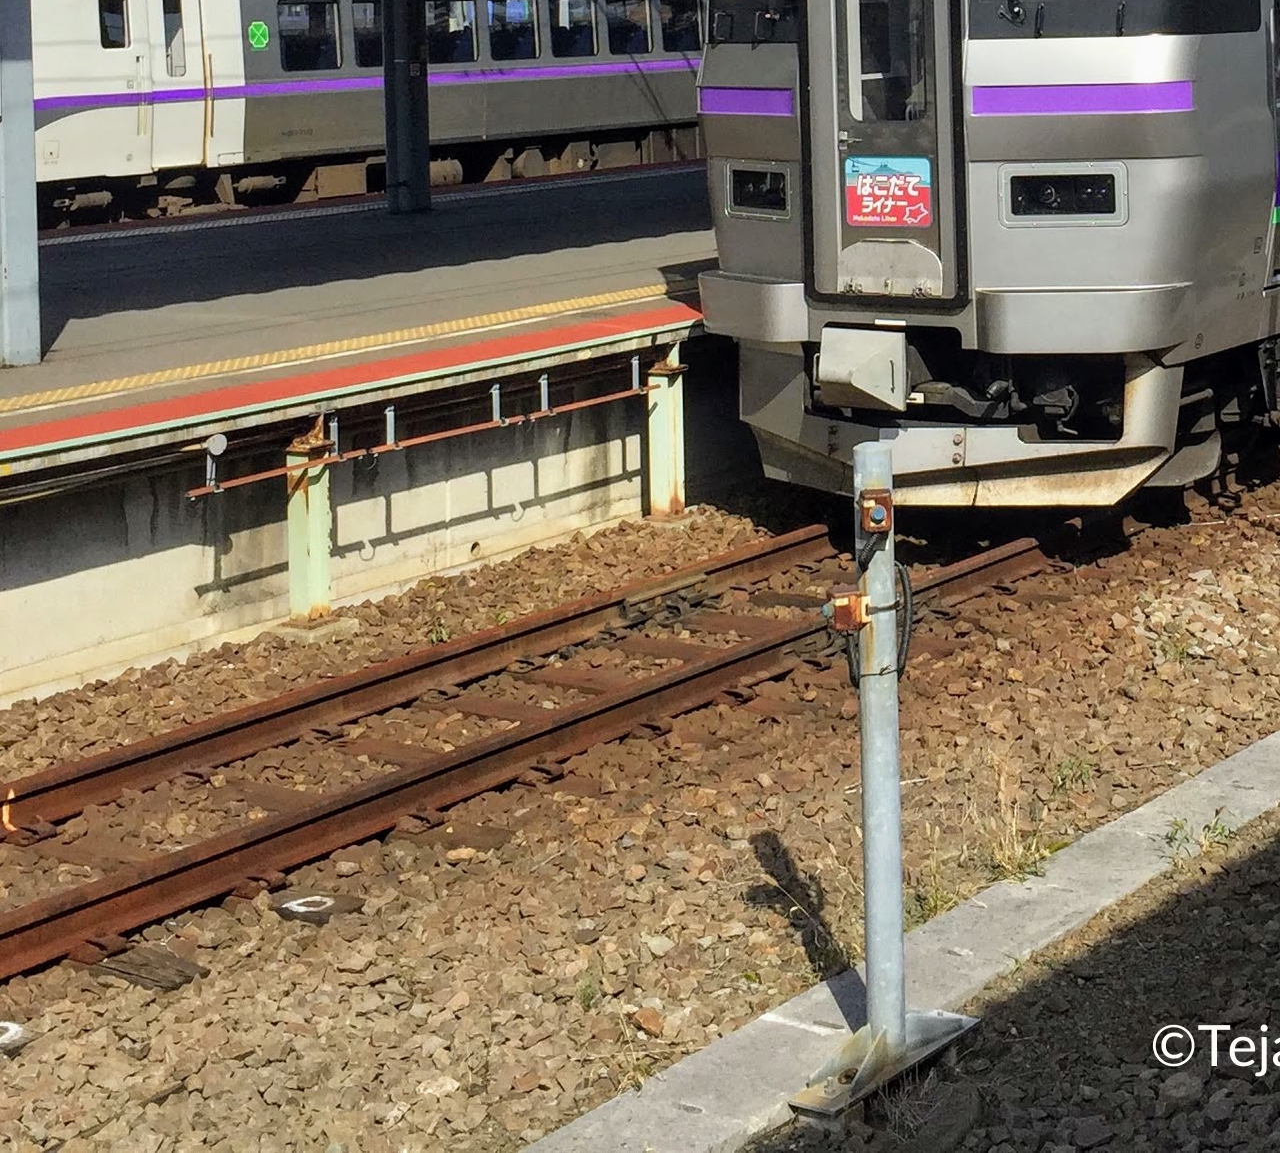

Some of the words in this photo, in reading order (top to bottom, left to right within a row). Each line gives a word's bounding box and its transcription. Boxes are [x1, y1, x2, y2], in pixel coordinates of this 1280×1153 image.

[857, 174, 921, 197] はこだて
[861, 196, 909, 214] ライナー
